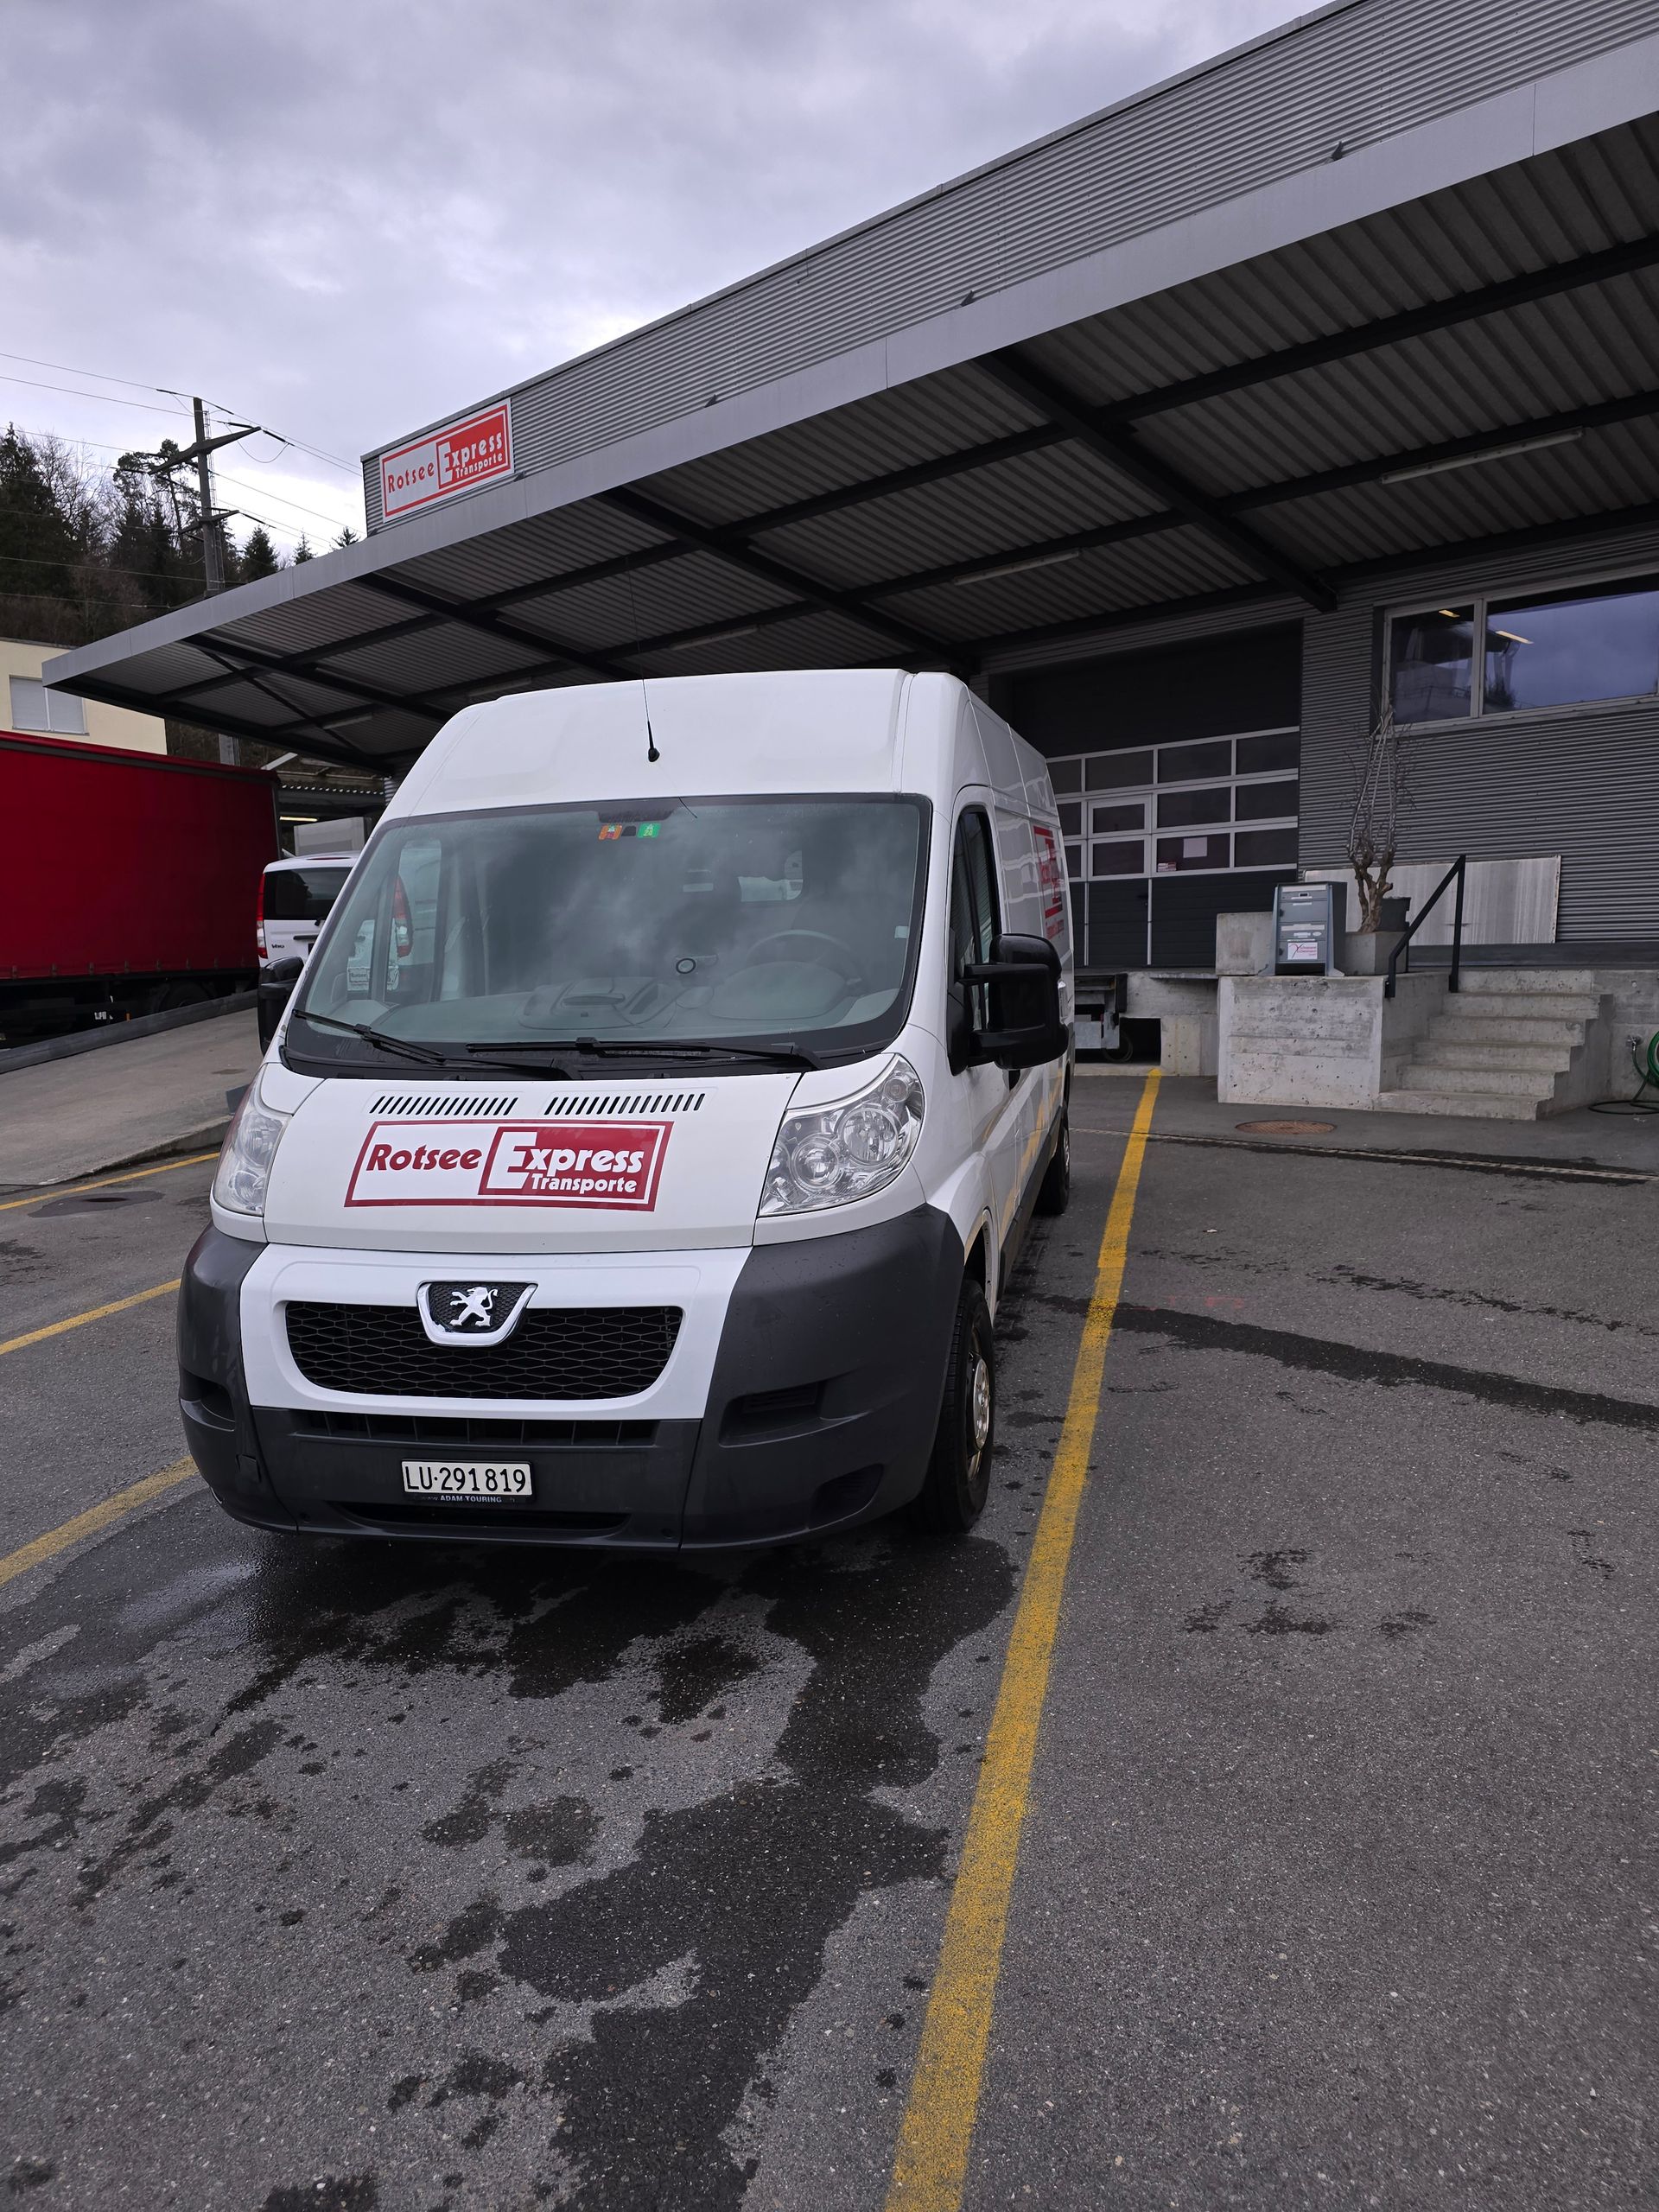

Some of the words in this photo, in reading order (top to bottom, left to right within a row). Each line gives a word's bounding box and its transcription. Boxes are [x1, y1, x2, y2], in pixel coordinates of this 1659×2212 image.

[388, 462, 435, 493] Rotsee
[438, 432, 502, 486] Express
[455, 452, 503, 479] Transporte
[365, 1143, 483, 1172] Rotsee
[486, 1131, 645, 1189] Express
[531, 1173, 637, 1194] Transporte
